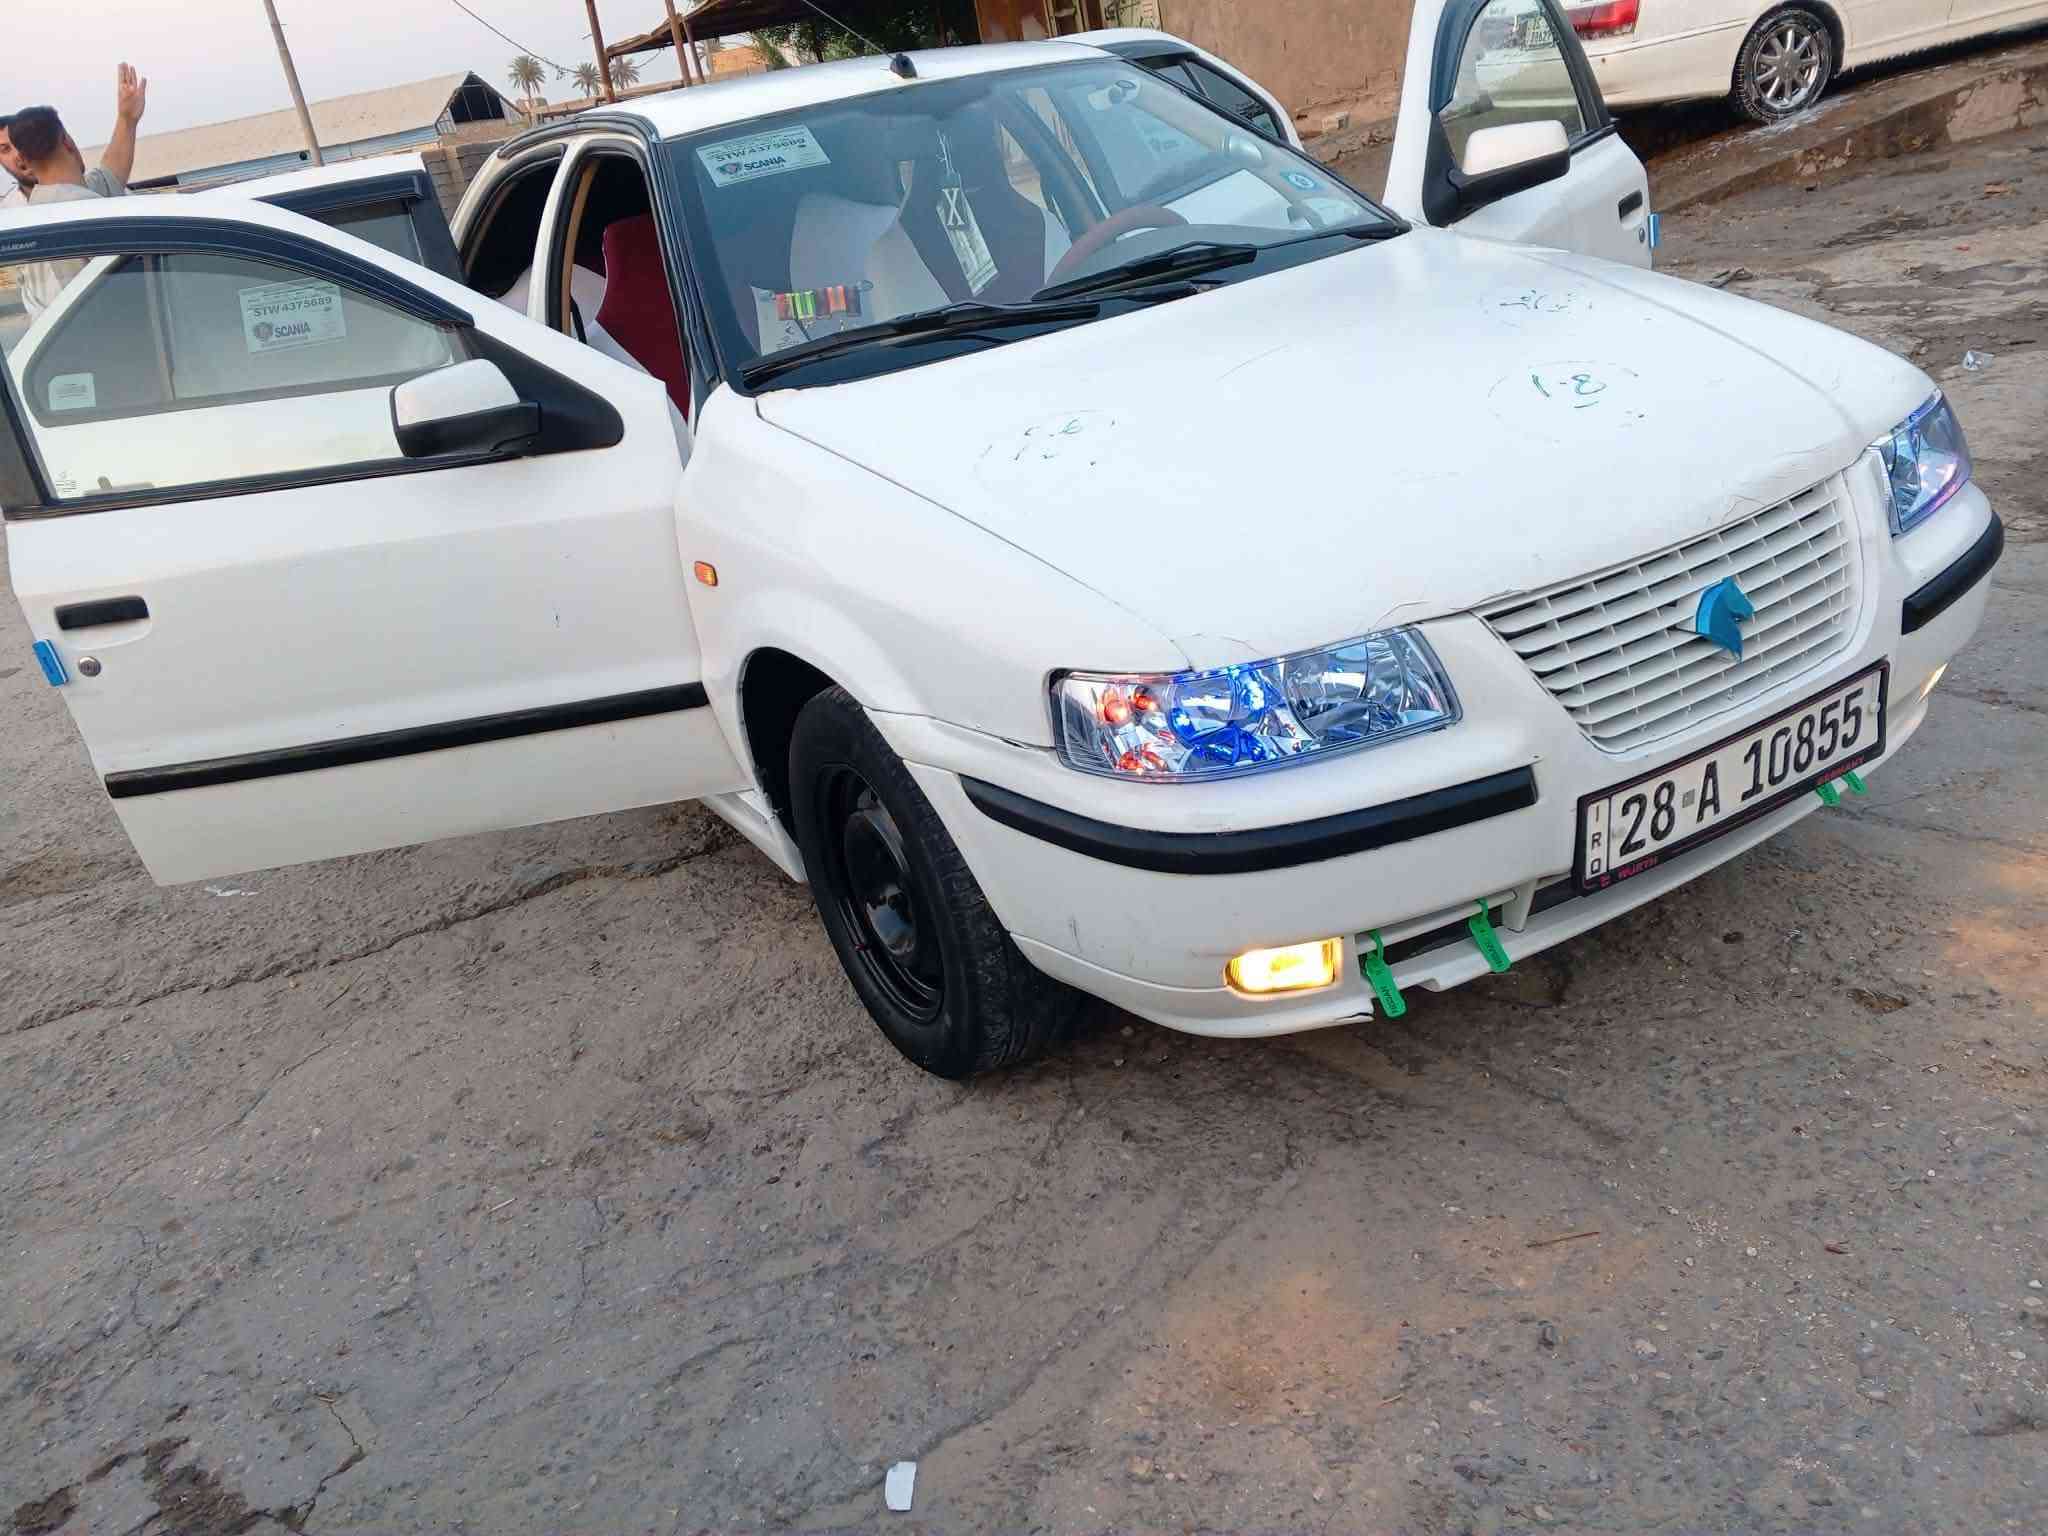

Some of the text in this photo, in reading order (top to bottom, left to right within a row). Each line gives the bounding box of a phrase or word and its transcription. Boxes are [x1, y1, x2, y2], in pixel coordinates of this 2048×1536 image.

[744, 156, 786, 171] SCANIA
[274, 321, 312, 338] SCANIA
[1620, 687, 1864, 857] 28 A 10855
